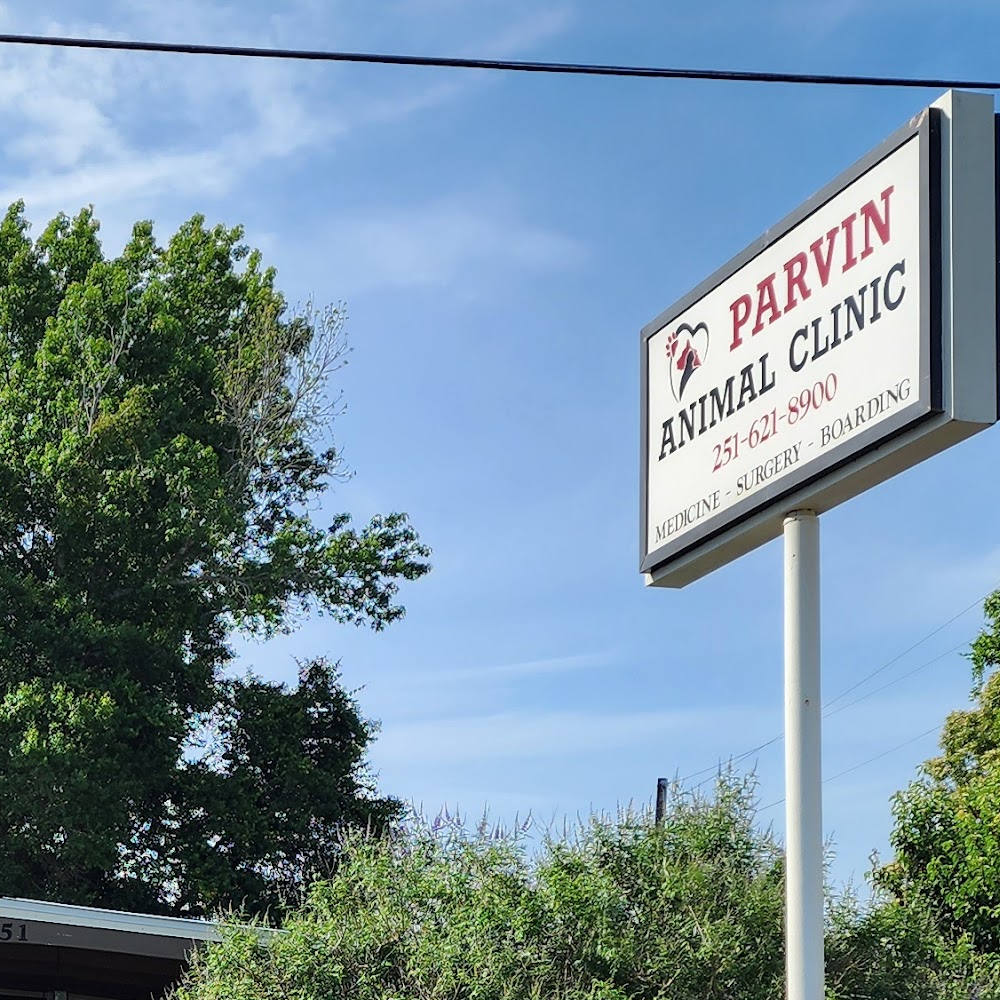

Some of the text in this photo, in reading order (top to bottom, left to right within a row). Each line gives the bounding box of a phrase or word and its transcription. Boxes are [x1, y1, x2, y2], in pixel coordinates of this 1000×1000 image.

[729, 185, 895, 352] PARVIN
[658, 259, 906, 461] ANIMAL CLINIC
[712, 372, 838, 473] 251-621-8900
[654, 490, 721, 543] MEDICINE
[736, 441, 802, 496] SURGERY
[820, 378, 911, 448] BOARDING
